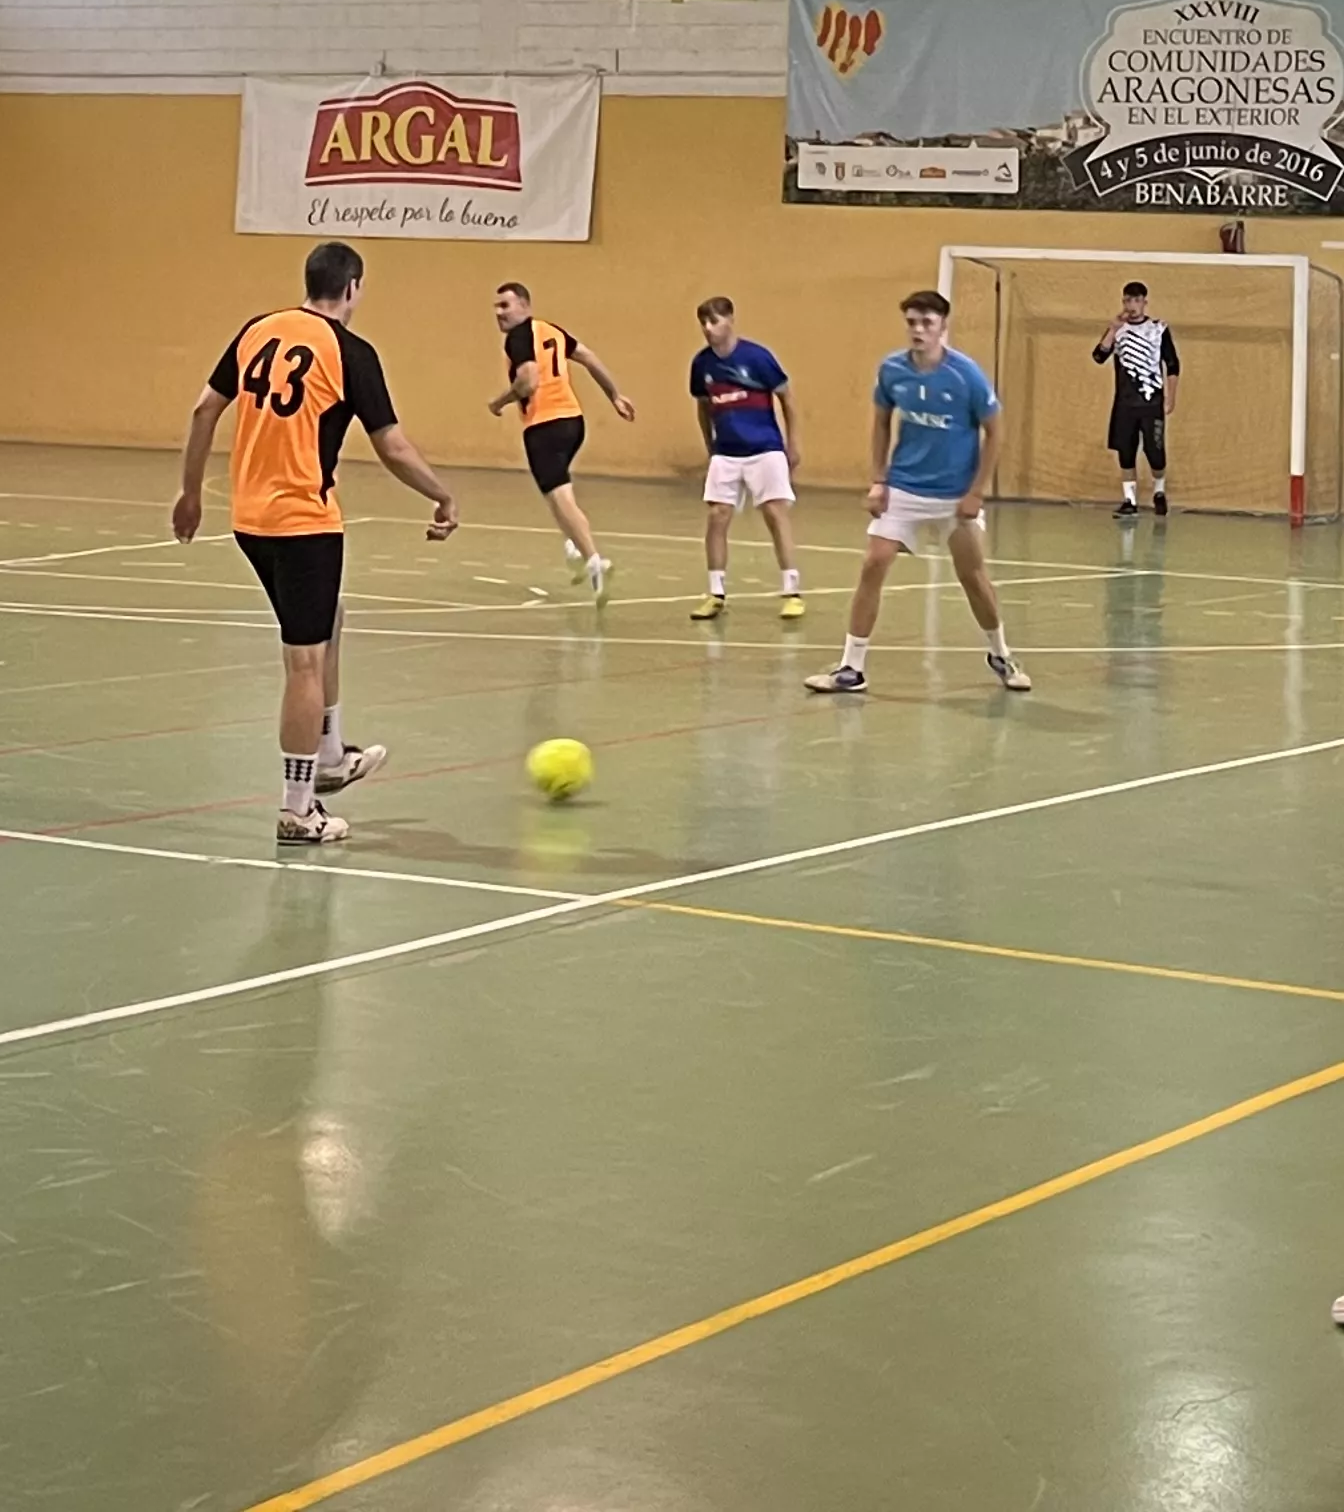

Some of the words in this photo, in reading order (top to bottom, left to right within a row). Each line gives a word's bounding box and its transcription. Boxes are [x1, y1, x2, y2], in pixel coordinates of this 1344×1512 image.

[1174, 0, 1260, 25] XXXVIII
[1142, 28, 1262, 46] ENCUENTRO
[1266, 28, 1293, 45] DE
[1107, 49, 1326, 73] COMUNIDADES
[1097, 76, 1336, 105] ARAGONESAS
[1127, 107, 1158, 126] EN
[1163, 107, 1190, 126] EL
[1195, 107, 1301, 126] EXTERIOR
[319, 105, 509, 168] ARGAL
[1099, 159, 1113, 180] 4
[1116, 156, 1132, 179] y
[1135, 148, 1149, 168] 5
[1153, 142, 1181, 164] de
[1184, 140, 1241, 166] junio
[1245, 143, 1272, 165] de
[1273, 148, 1327, 182] 2016
[1135, 182, 1290, 207] BENABARRE
[307, 197, 329, 228] El
[332, 199, 397, 229] respeto
[400, 205, 432, 229] por
[460, 199, 522, 230] bueno
[542, 337, 561, 378] 7
[243, 337, 315, 418] 43
